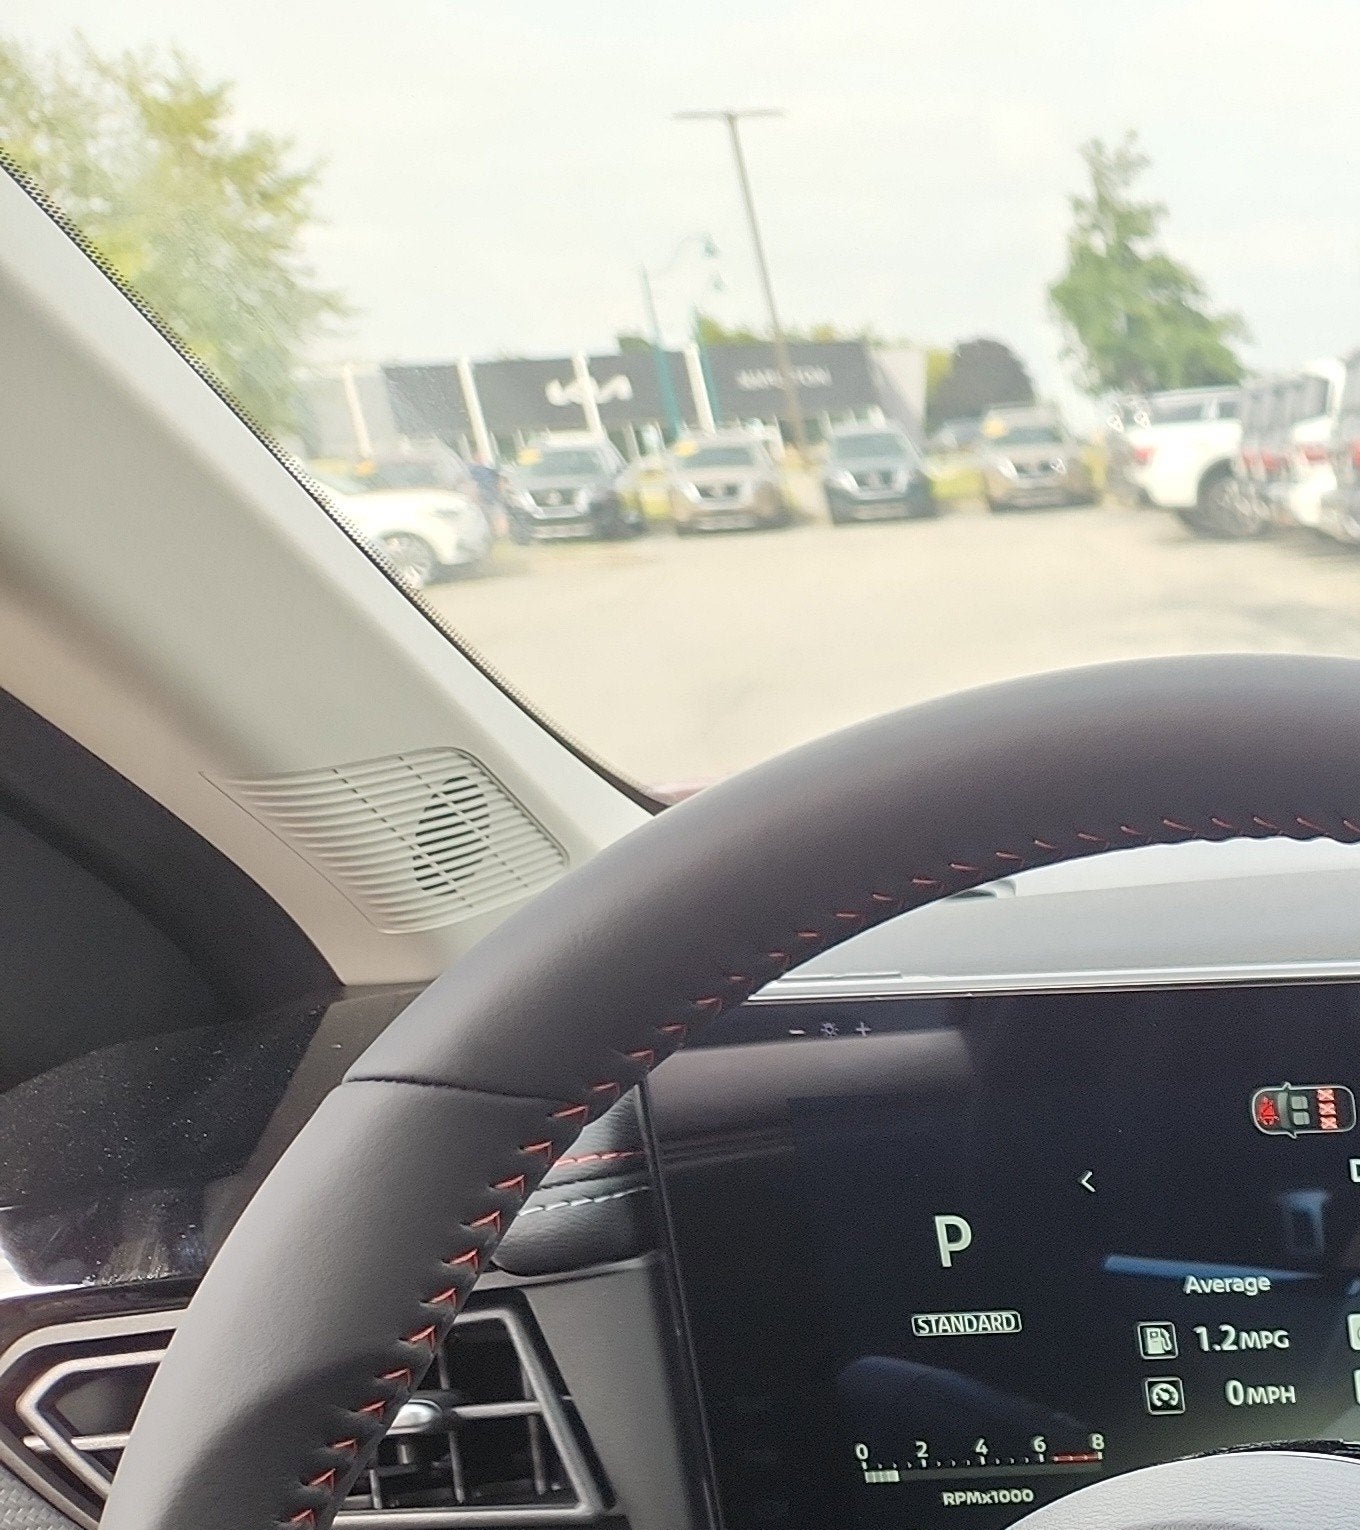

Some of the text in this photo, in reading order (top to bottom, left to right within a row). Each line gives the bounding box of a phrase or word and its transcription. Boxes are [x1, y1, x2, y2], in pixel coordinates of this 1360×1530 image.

[934, 1215, 972, 1268] P
[1183, 1274, 1271, 1296] Average
[917, 1313, 1017, 1334] STANDARD
[855, 1432, 1105, 1460] 0 2 4 6 8
[942, 1488, 1035, 1507] RPMx1000
